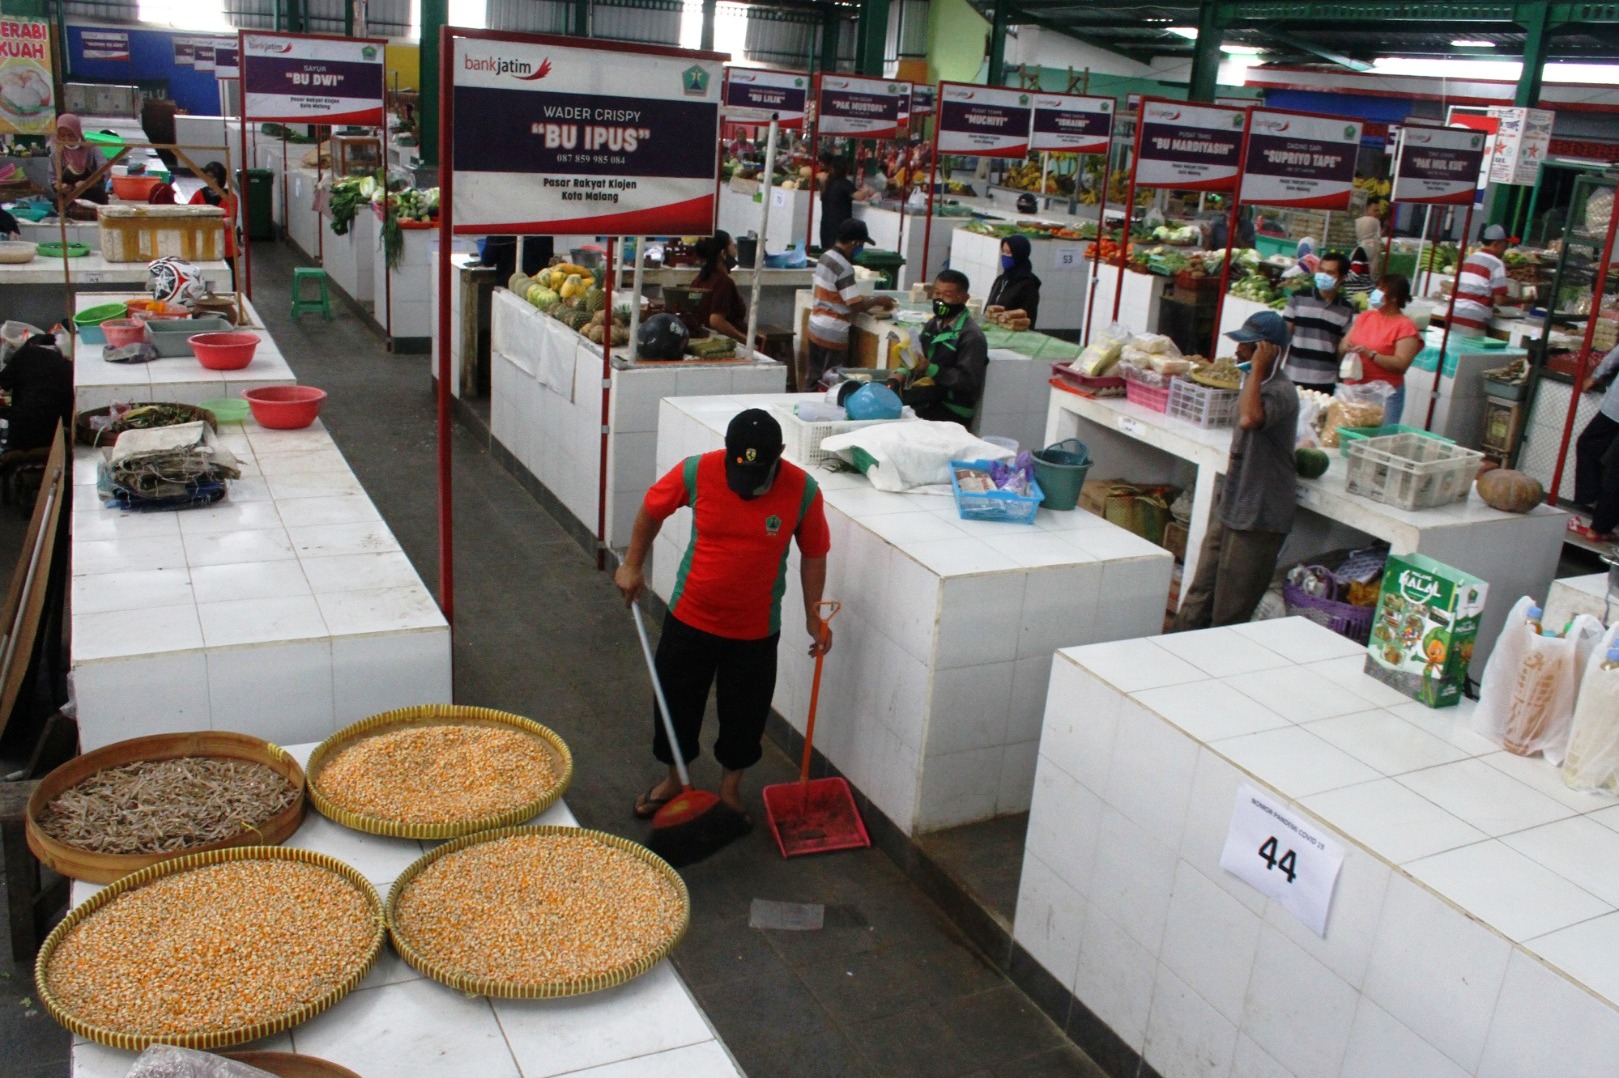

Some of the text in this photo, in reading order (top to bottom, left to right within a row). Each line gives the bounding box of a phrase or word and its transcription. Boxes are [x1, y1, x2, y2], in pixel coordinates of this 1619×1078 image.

[0, 22, 47, 40] ERABI
[465, 54, 532, 76] bankjatim
[543, 106, 641, 123] WADER CRISPY
[556, 154, 626, 165] 087 859 985 084
[543, 178, 637, 190] Pasar Rakyat Klojen
[561, 191, 618, 203] Kota Malang
[1298, 829, 1317, 845] COVID
[1258, 836, 1297, 883] 44
